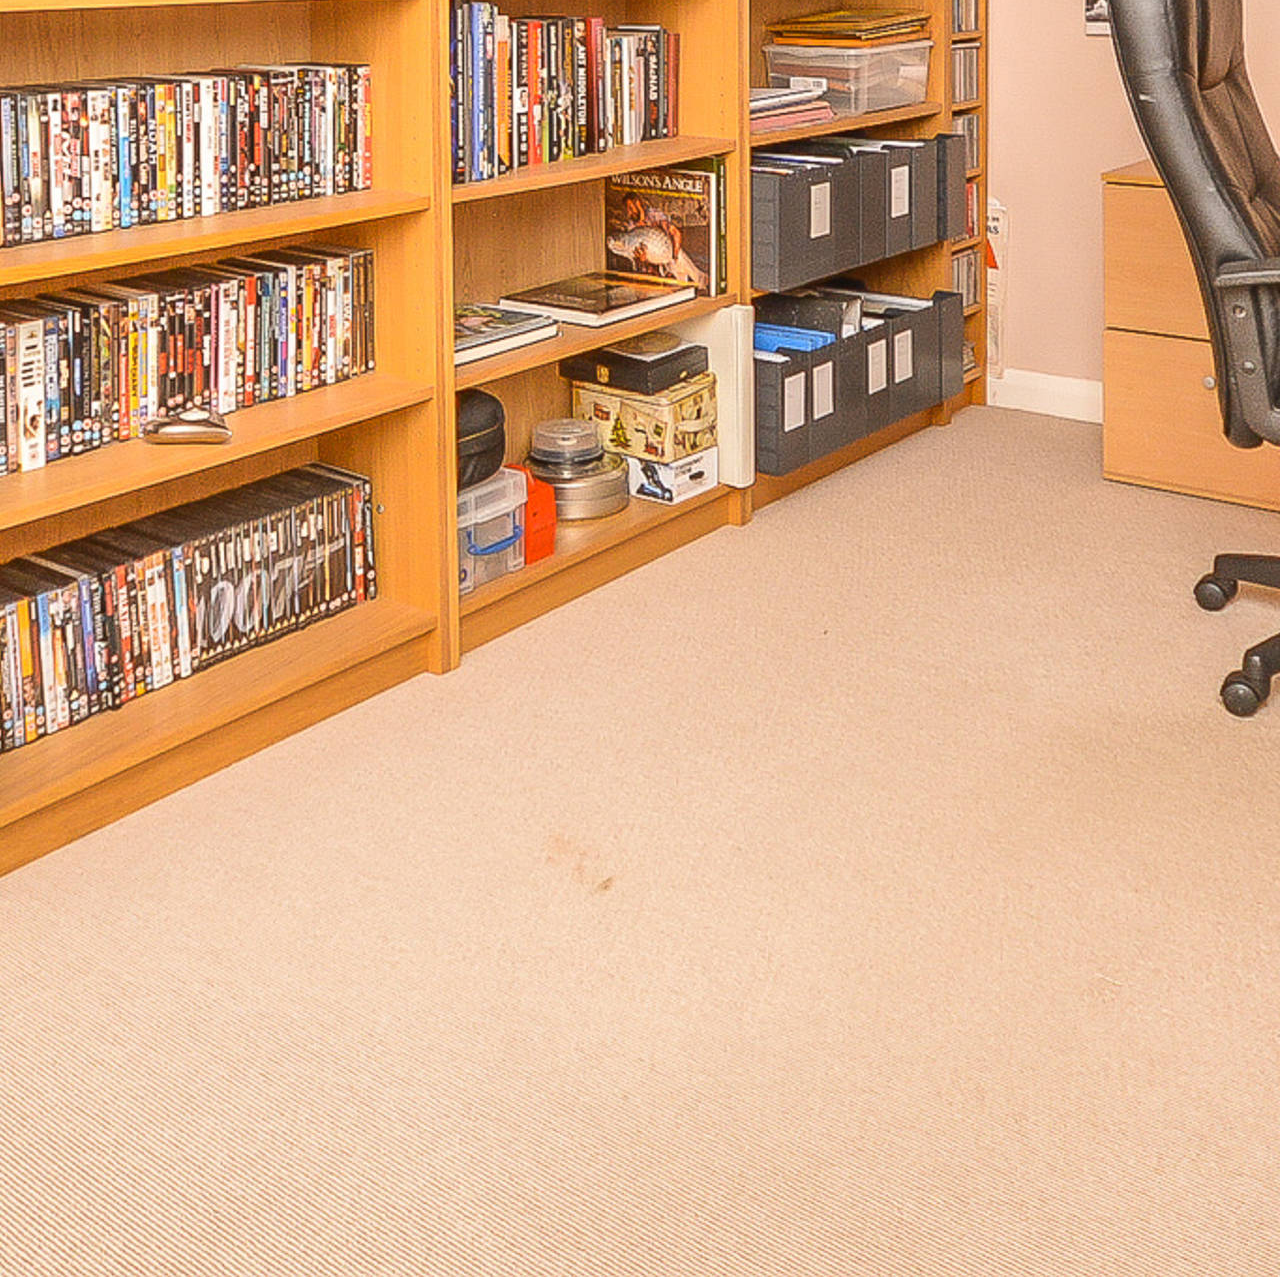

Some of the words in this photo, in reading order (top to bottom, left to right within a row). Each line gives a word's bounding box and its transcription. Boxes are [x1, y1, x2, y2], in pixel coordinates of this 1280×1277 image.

[577, 45, 587, 66] ANT
[577, 67, 587, 125] MIDDLETON
[149, 119, 158, 165] NOAH
[611, 174, 662, 189] WILSON'S
[662, 177, 703, 193] ANGLE
